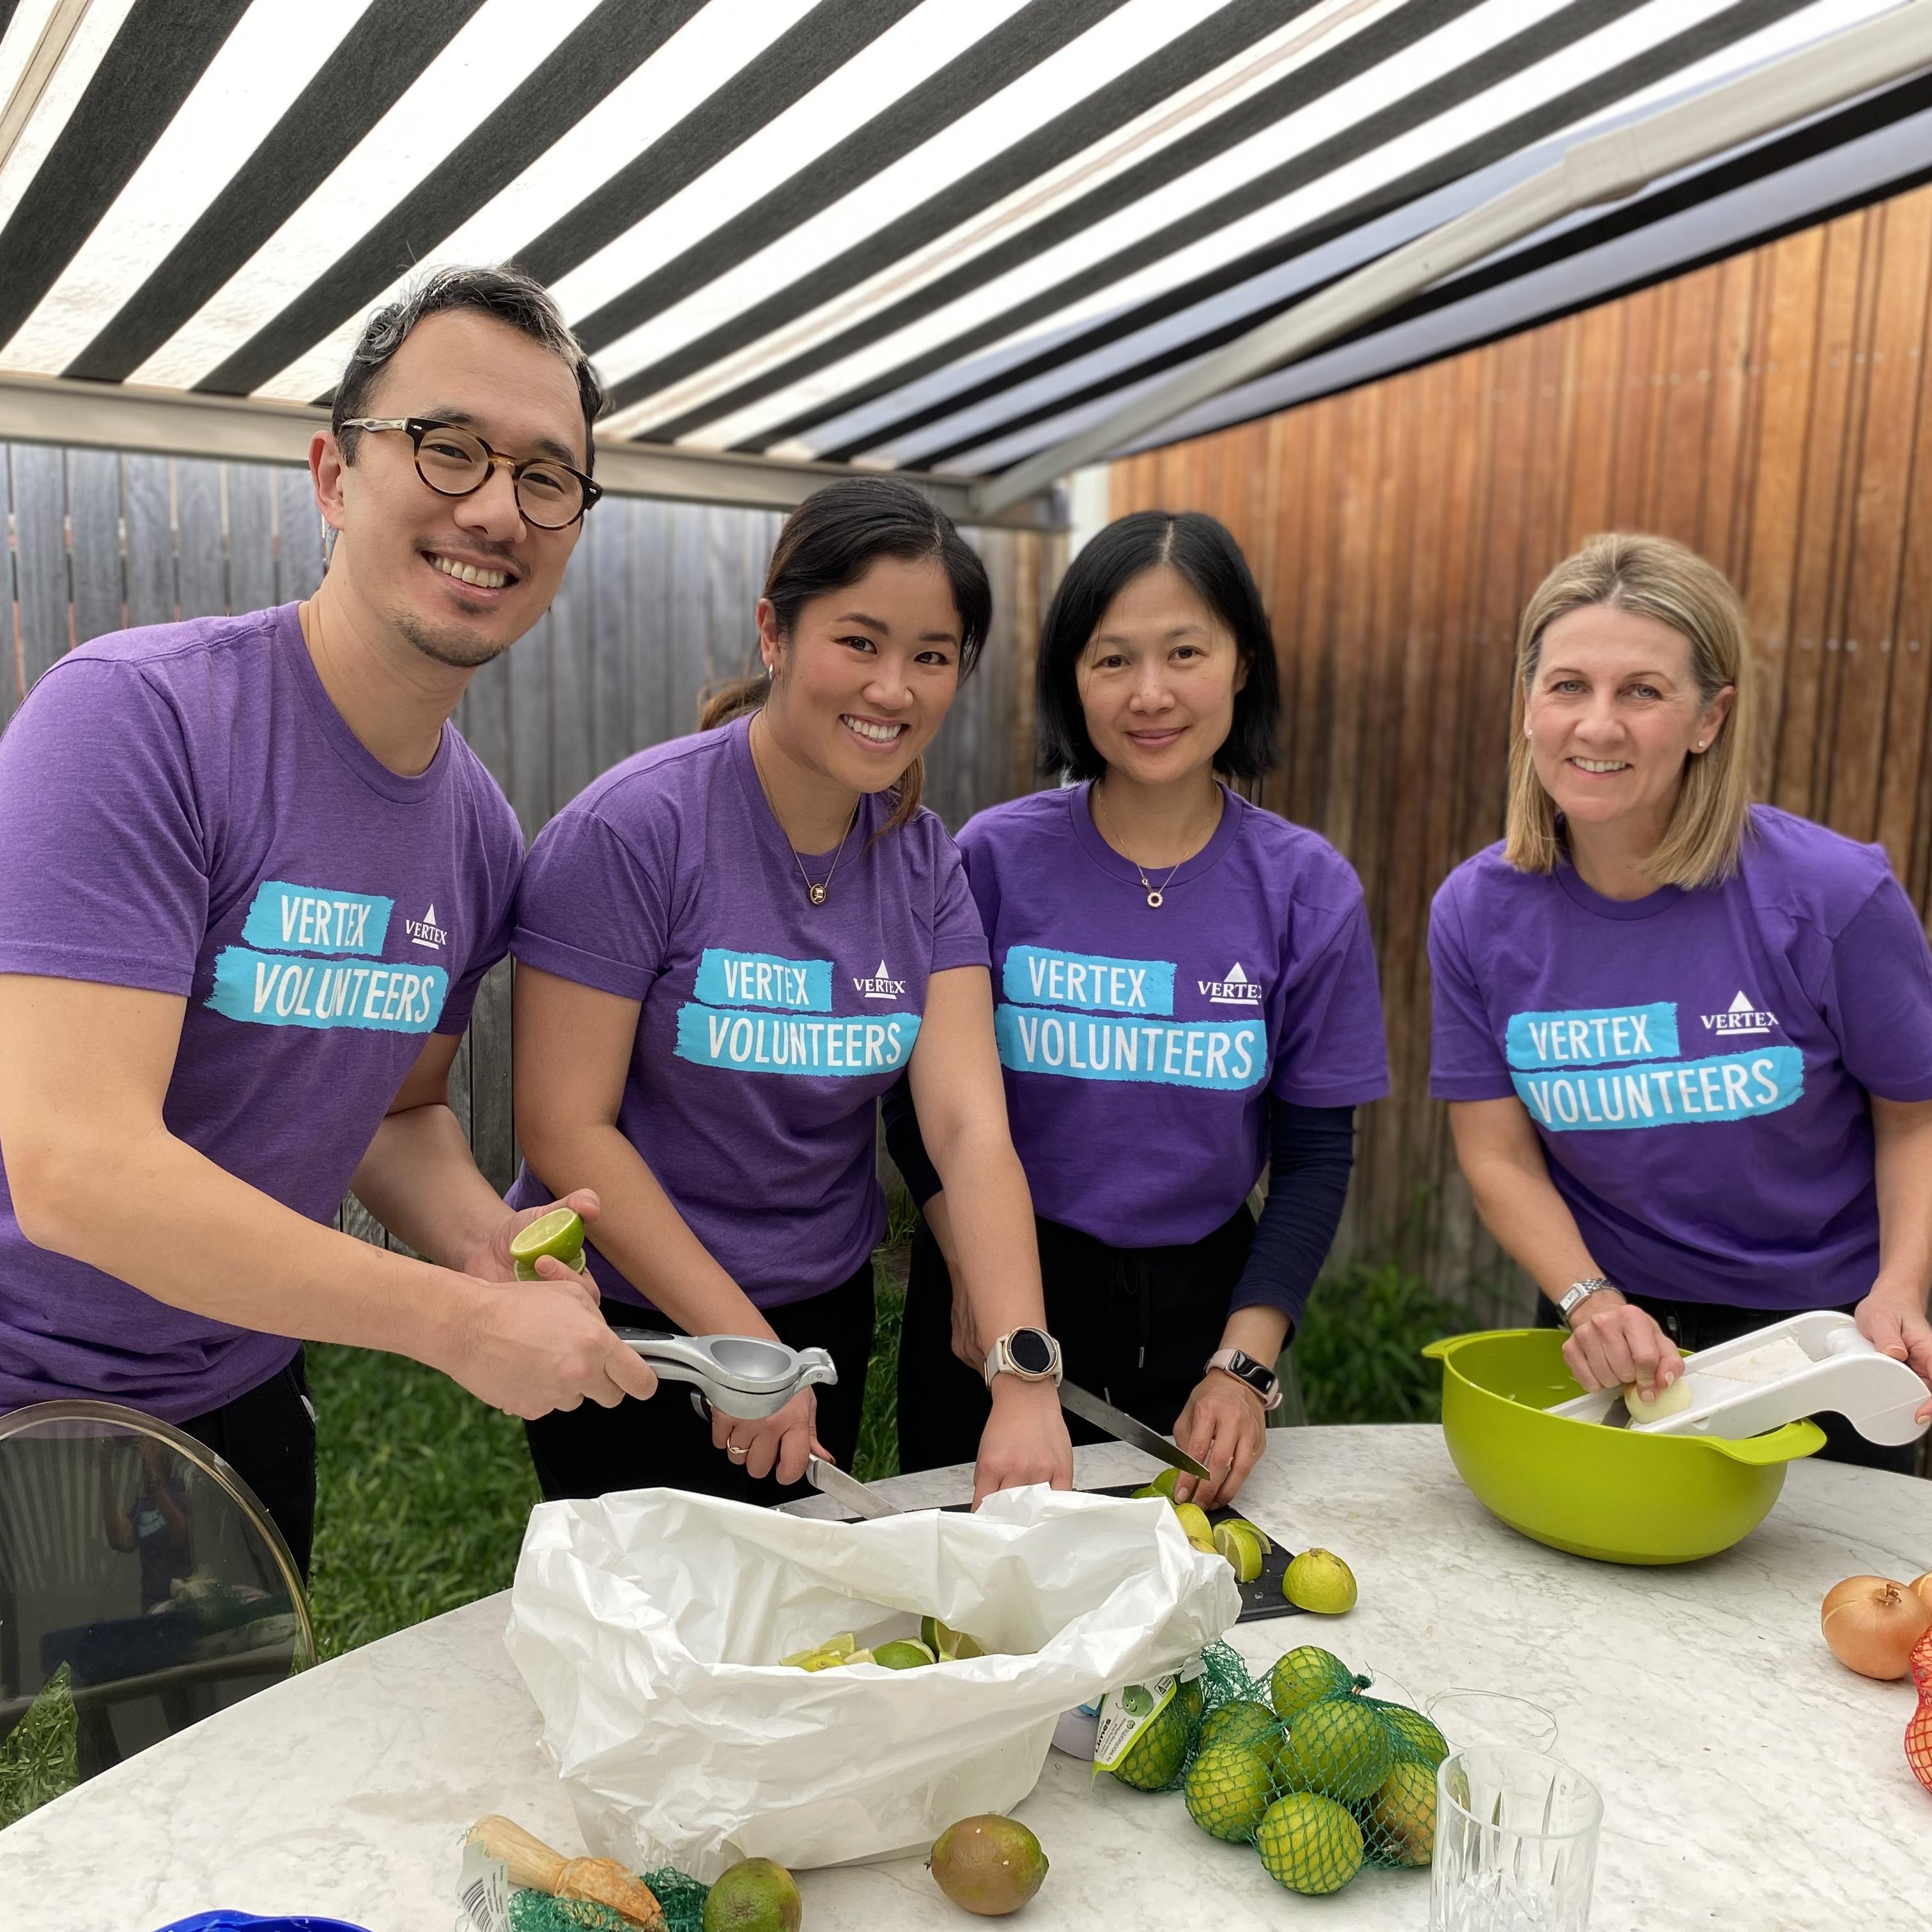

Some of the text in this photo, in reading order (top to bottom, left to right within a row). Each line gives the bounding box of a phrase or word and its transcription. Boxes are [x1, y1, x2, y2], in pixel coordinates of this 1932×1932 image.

[281, 895, 371, 947] VERTEX
[405, 919, 447, 946] VERTEX
[253, 961, 435, 1023] VOLUNTEERS
[723, 959, 810, 1005] VERTEX
[853, 977, 906, 994] VERTEX
[1028, 956, 1146, 1008] VERTEX
[709, 1015, 901, 1067] VOLUNTEERS
[1528, 1014, 1653, 1061] VERTEX
[1700, 1012, 1779, 1030] VERTEX
[1018, 1016, 1255, 1079] VOLUNTEERS
[1528, 1058, 1778, 1123] VOLUNTEERS
